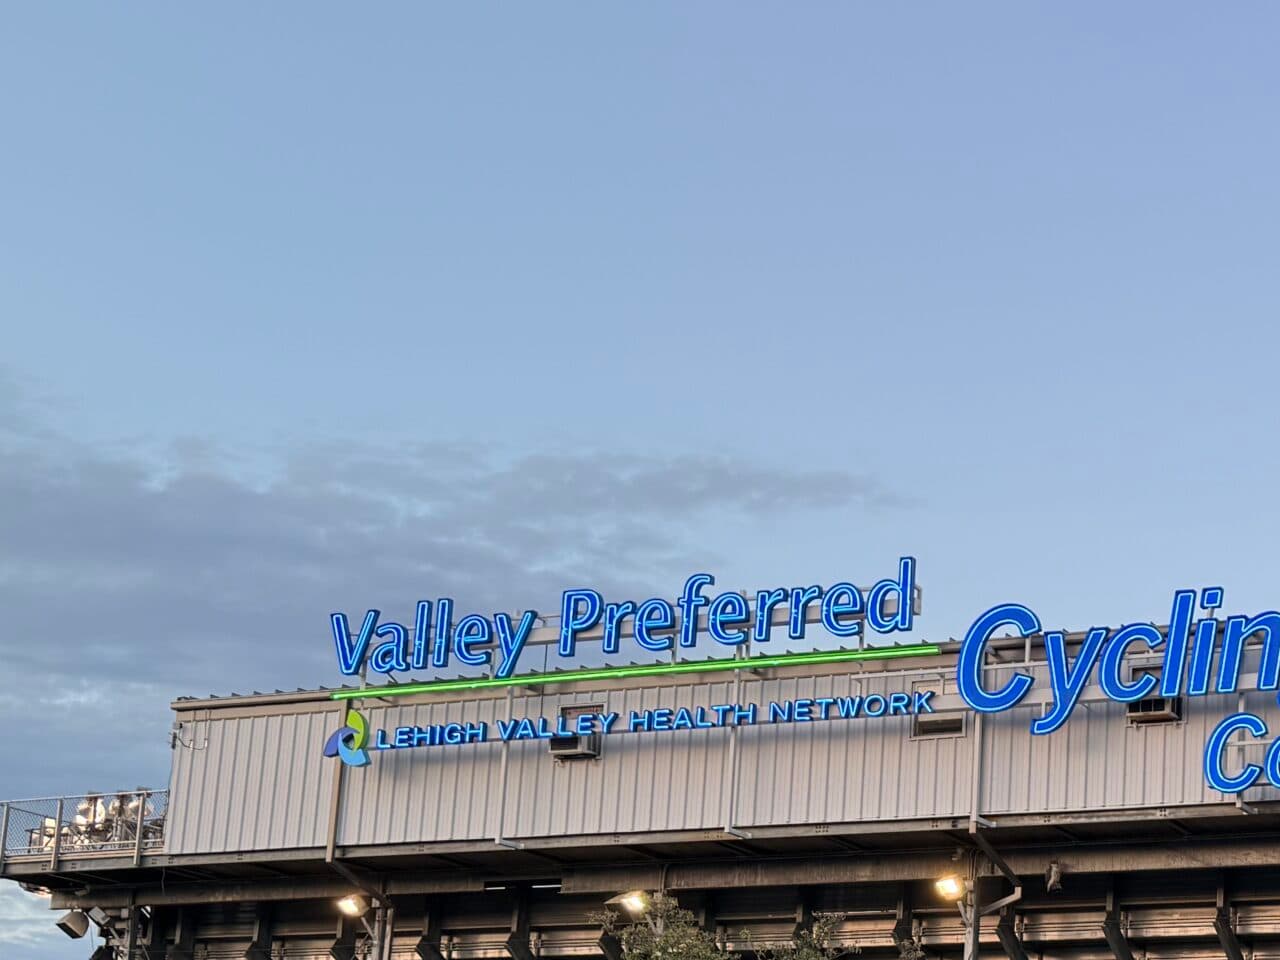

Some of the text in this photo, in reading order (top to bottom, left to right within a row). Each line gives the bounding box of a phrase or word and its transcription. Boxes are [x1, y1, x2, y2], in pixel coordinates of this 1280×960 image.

[331, 556, 916, 678] Valley Preferred
[375, 690, 936, 750] LEHIGH VALLEY HEALTH NETWORK
